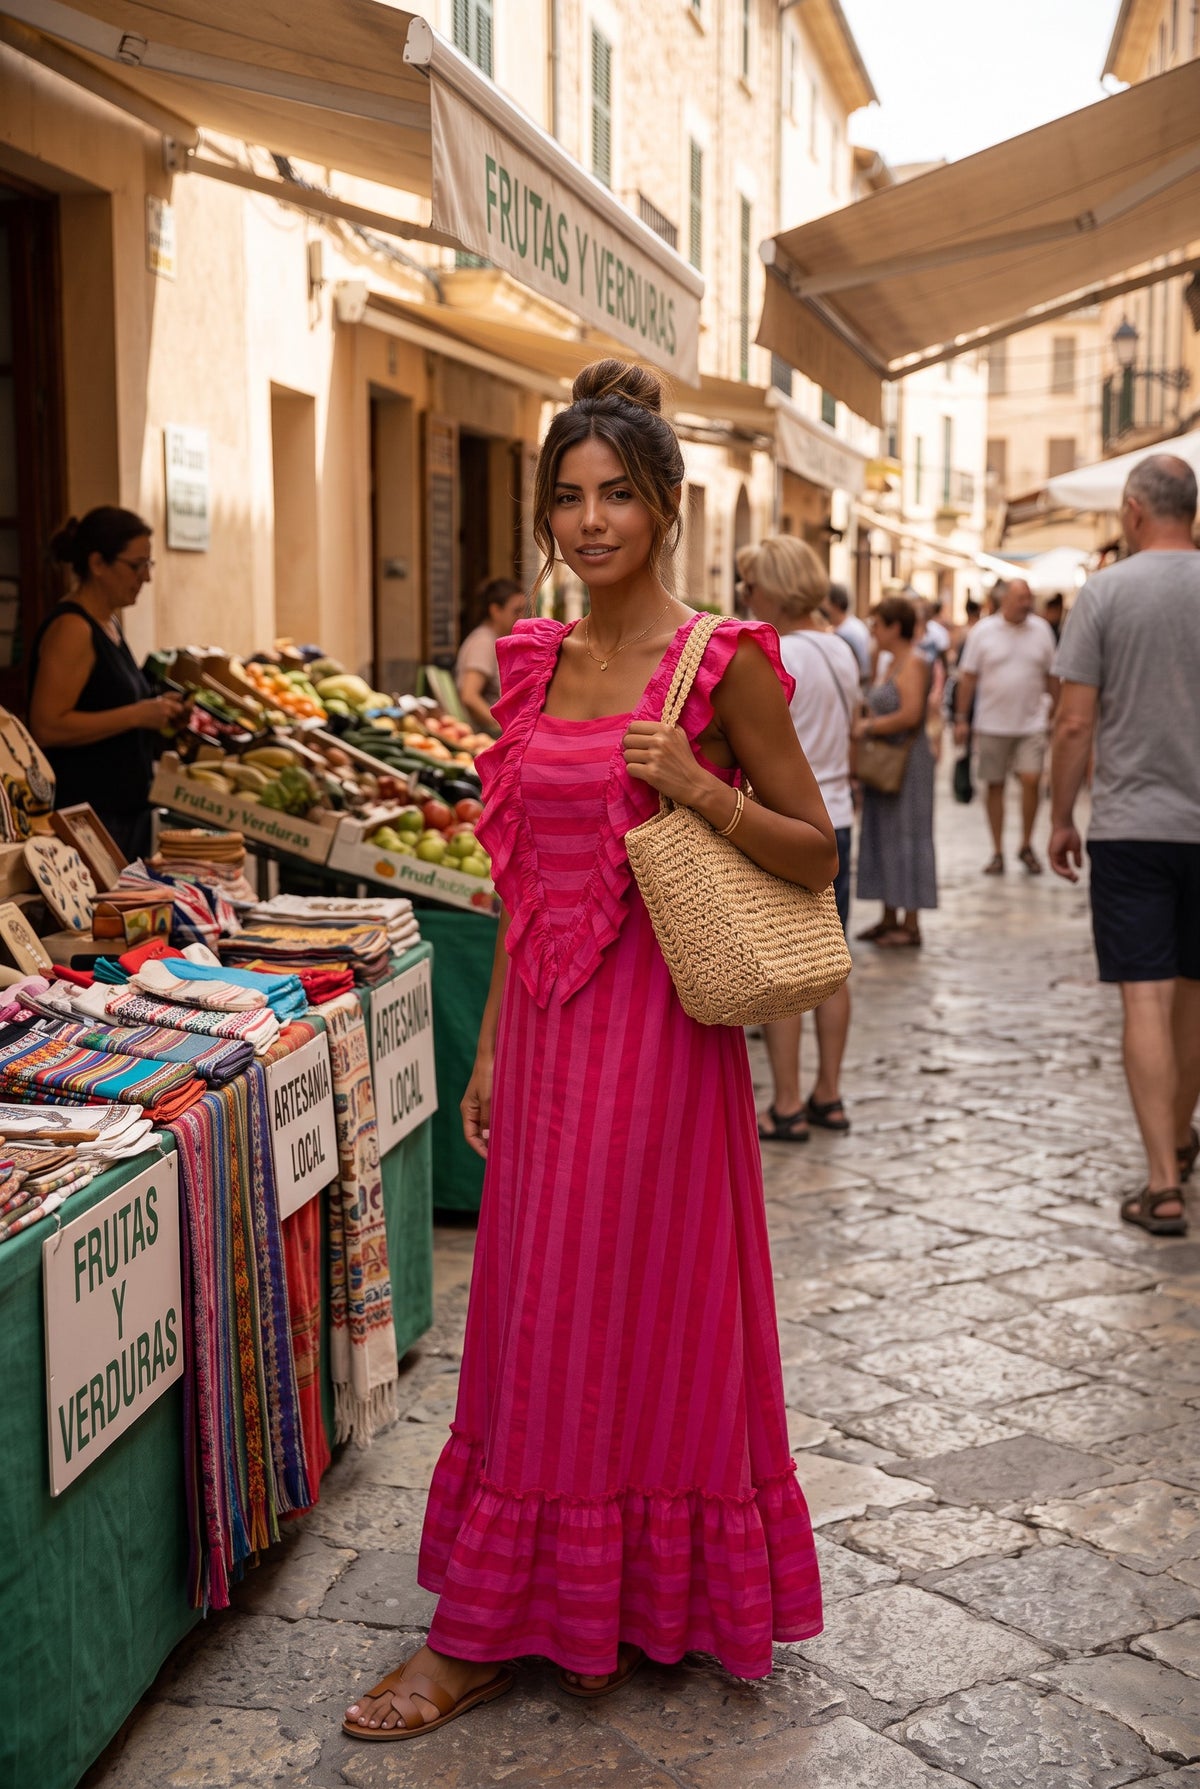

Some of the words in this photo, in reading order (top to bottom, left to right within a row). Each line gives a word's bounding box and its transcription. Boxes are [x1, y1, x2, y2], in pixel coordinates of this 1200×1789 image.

[485, 153, 570, 286] FRUTAS
[575, 224, 588, 297] Y
[593, 238, 676, 357] VERDURAS
[174, 785, 223, 816] Frutas
[226, 807, 238, 823] y
[241, 809, 310, 848] Verduras
[375, 972, 430, 1062] ARTESANÍA
[274, 1051, 330, 1131] ARTESANÍA
[389, 1059, 423, 1125] LOCAL
[290, 1125, 326, 1183] LOCAL
[73, 1185, 159, 1304] FRUTAS
[111, 1279, 127, 1341] Y
[58, 1308, 178, 1464] VERDURAS
